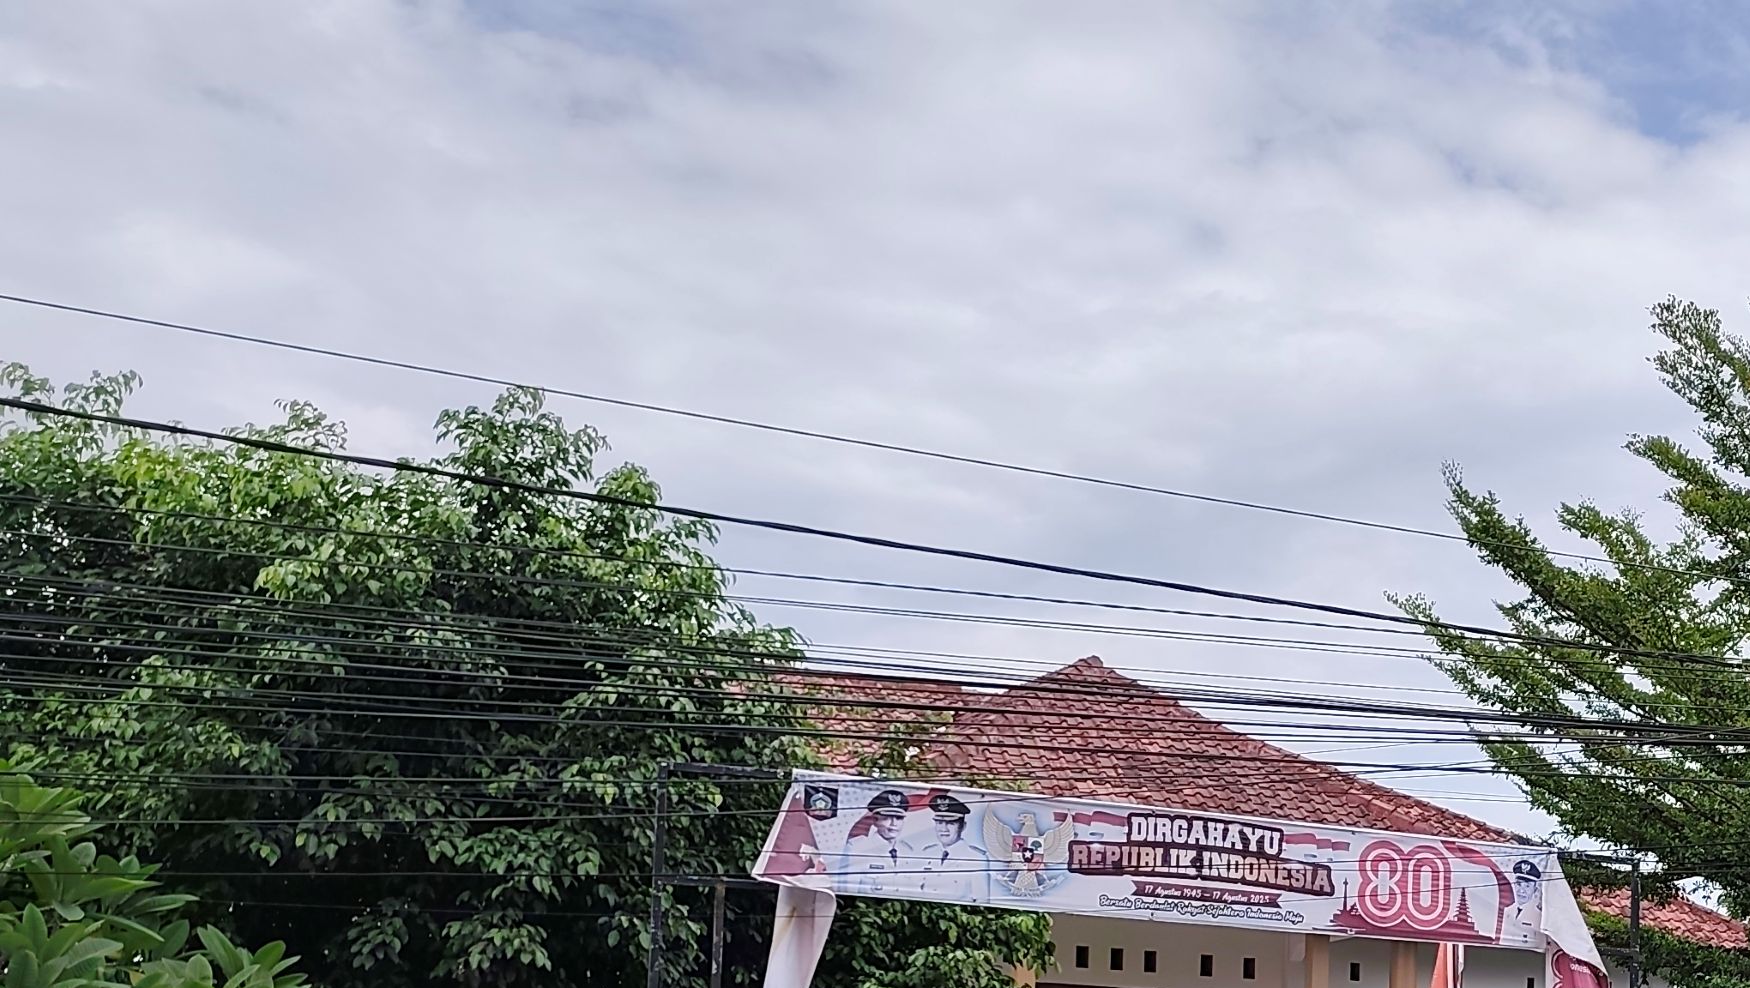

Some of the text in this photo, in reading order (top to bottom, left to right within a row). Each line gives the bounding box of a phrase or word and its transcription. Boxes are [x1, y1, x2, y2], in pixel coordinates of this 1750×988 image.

[1130, 815, 1281, 855] DIRGAHAYU
[1071, 844, 1332, 893] REPUBLIK INDONESIA
[1358, 840, 1451, 930] 80
[1100, 895, 1132, 908] Bersatu
[1177, 901, 1207, 916] Rakyat
[1207, 903, 1244, 918] Sejahtera
[1246, 907, 1283, 921] Indonesia
[1284, 911, 1304, 925] Maju
[1144, 885, 1153, 894] 17
[1155, 886, 1181, 898] Agustus
[1183, 887, 1202, 898] 1945
[1212, 891, 1221, 900] 17
[1222, 892, 1248, 904] Agustus
